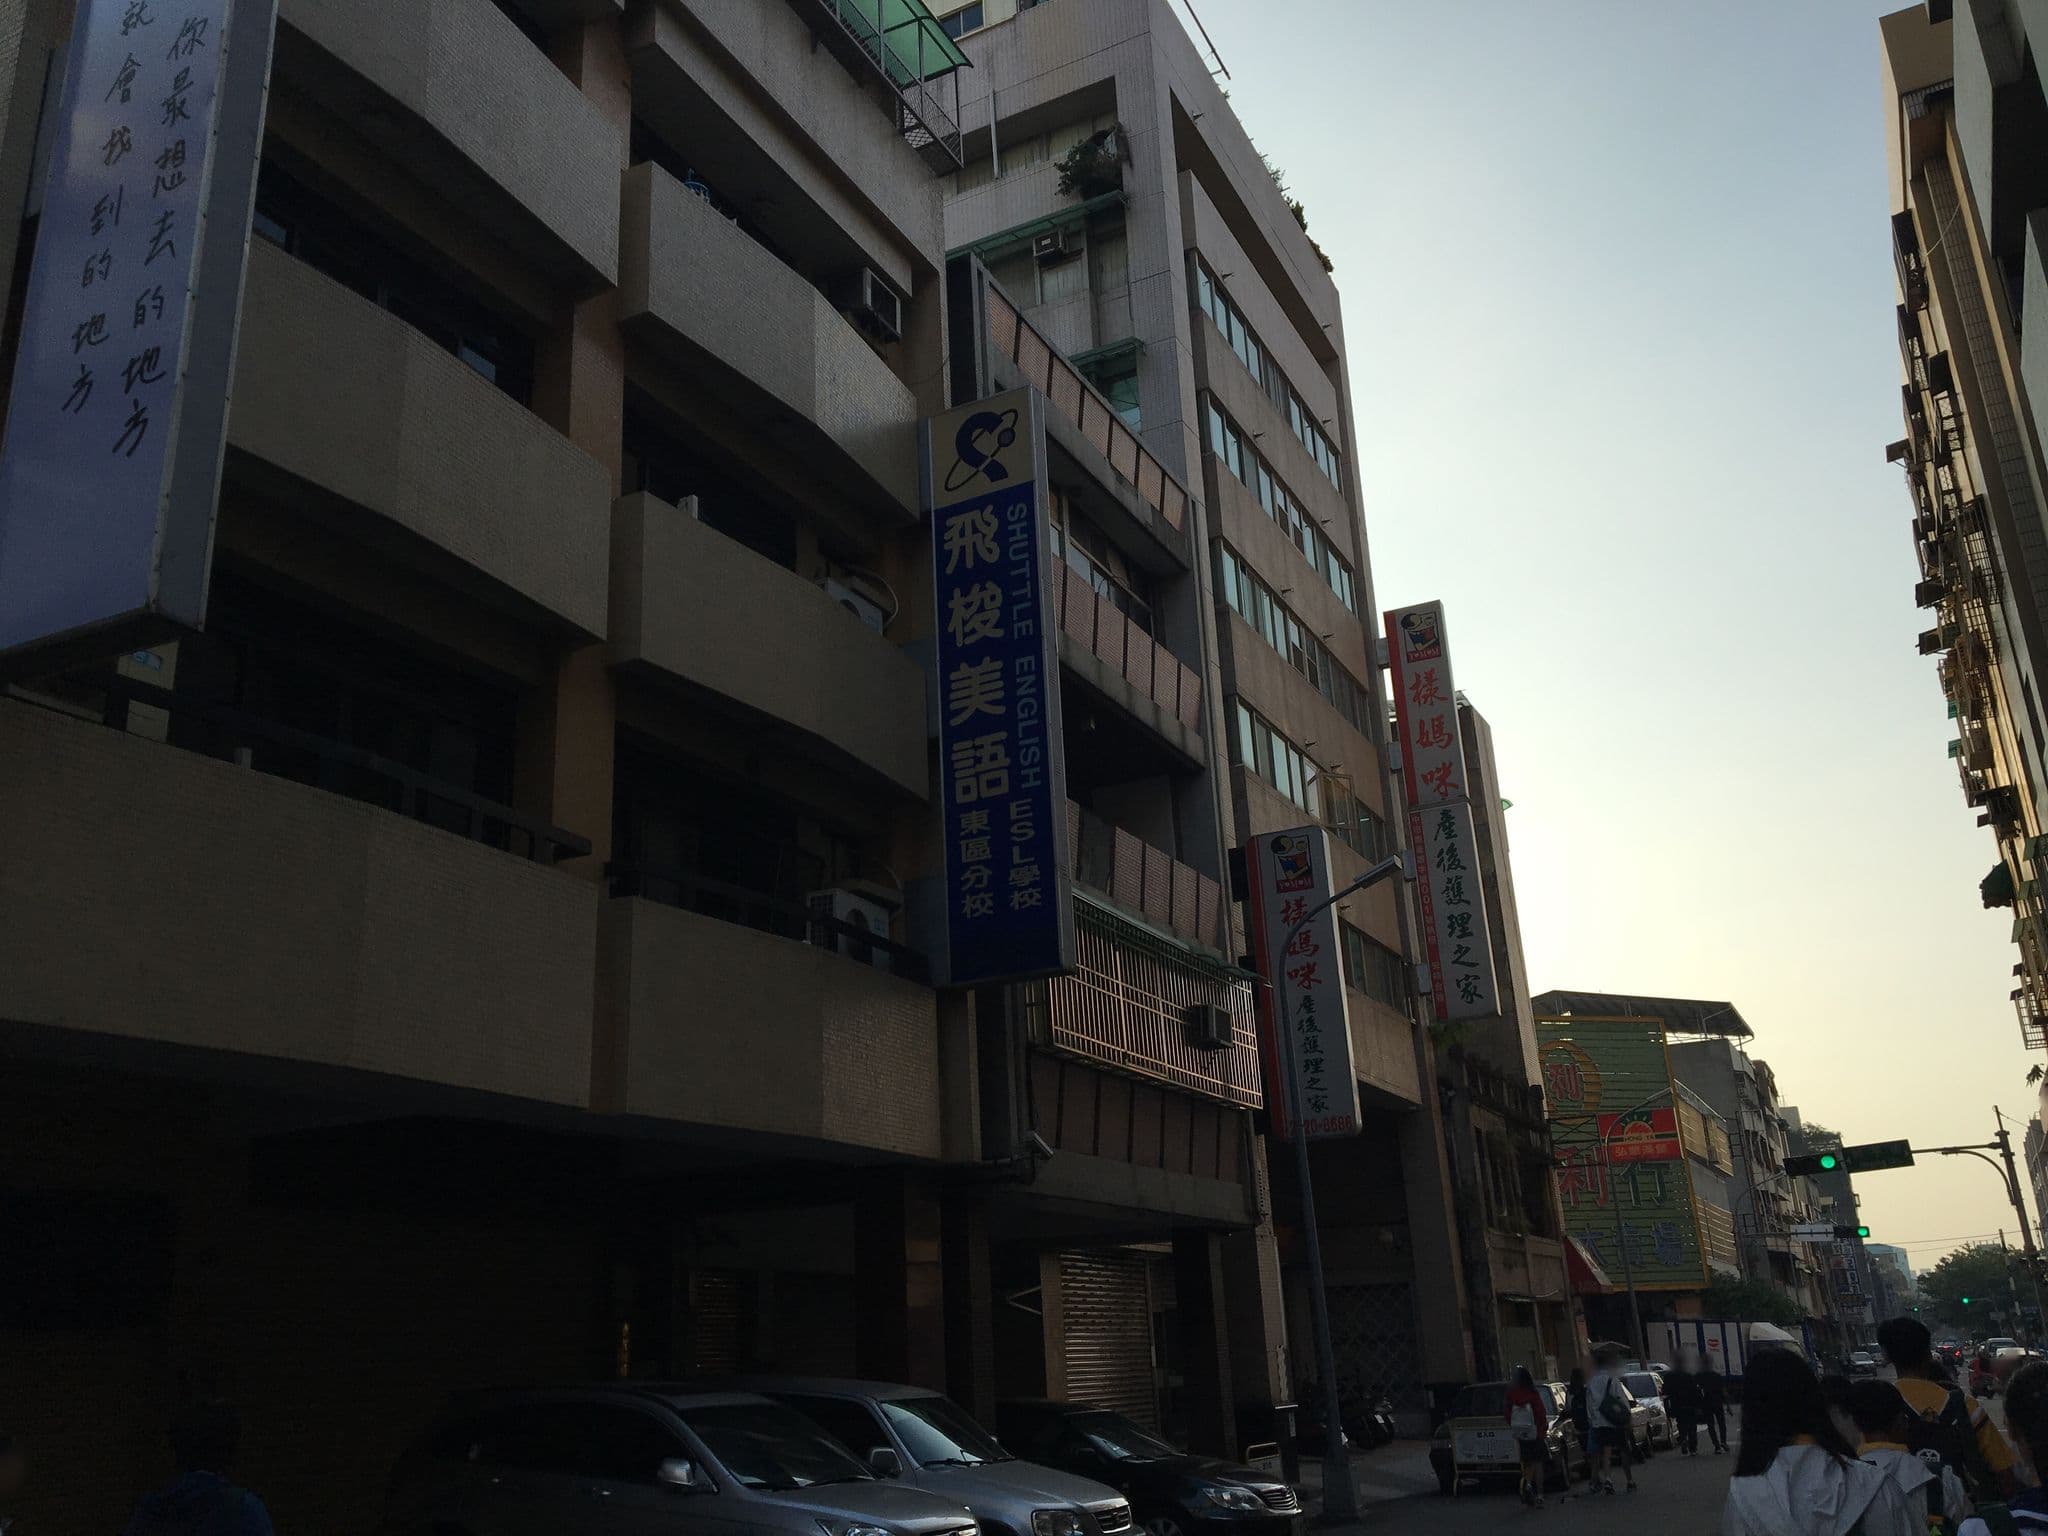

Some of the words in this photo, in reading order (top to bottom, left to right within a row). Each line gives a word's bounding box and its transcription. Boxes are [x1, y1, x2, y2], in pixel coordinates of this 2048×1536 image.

[113, 17, 208, 457] 你最想去的地方
[1007, 503, 1034, 640] SHUTTLE
[944, 504, 1011, 804] 飛梭美語
[1015, 655, 1041, 789] ENGLISH
[1409, 667, 1459, 798] 樣媽咪
[959, 808, 994, 920] 東區分校
[1434, 809, 1484, 1004] 產後護理之家
[1297, 995, 1330, 1114] 產後護理之家
